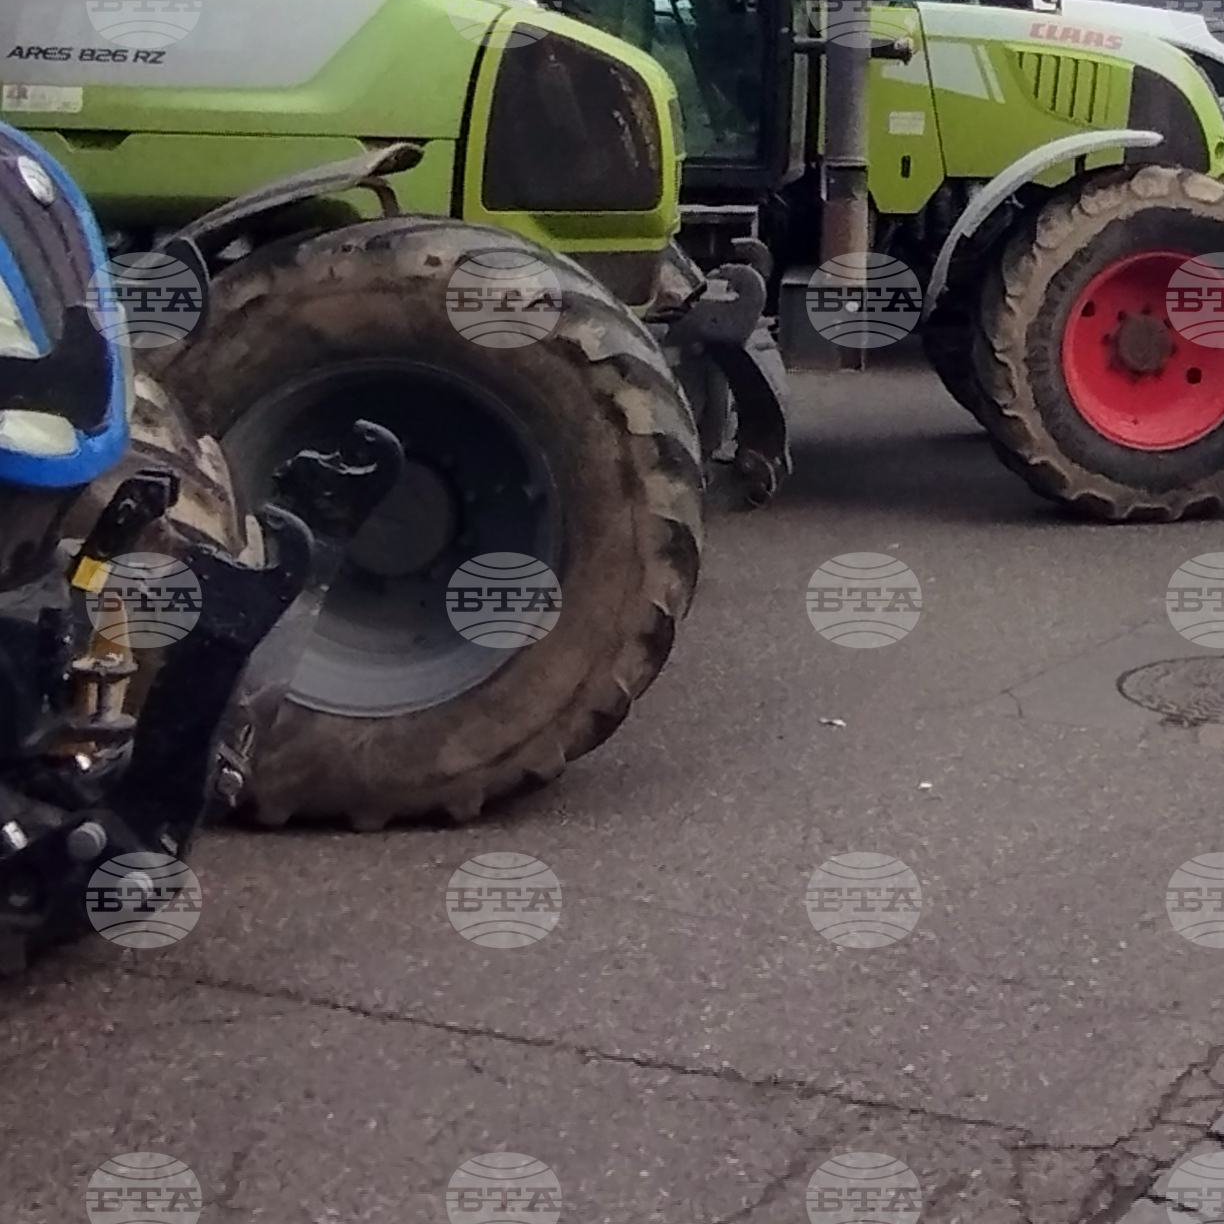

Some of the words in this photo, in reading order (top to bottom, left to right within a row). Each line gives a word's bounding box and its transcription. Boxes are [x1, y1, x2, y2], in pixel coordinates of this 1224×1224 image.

[1029, 22, 1122, 50] CLAAS
[6, 45, 74, 62] ARES
[78, 47, 129, 63] 826
[132, 48, 167, 65] RZ
